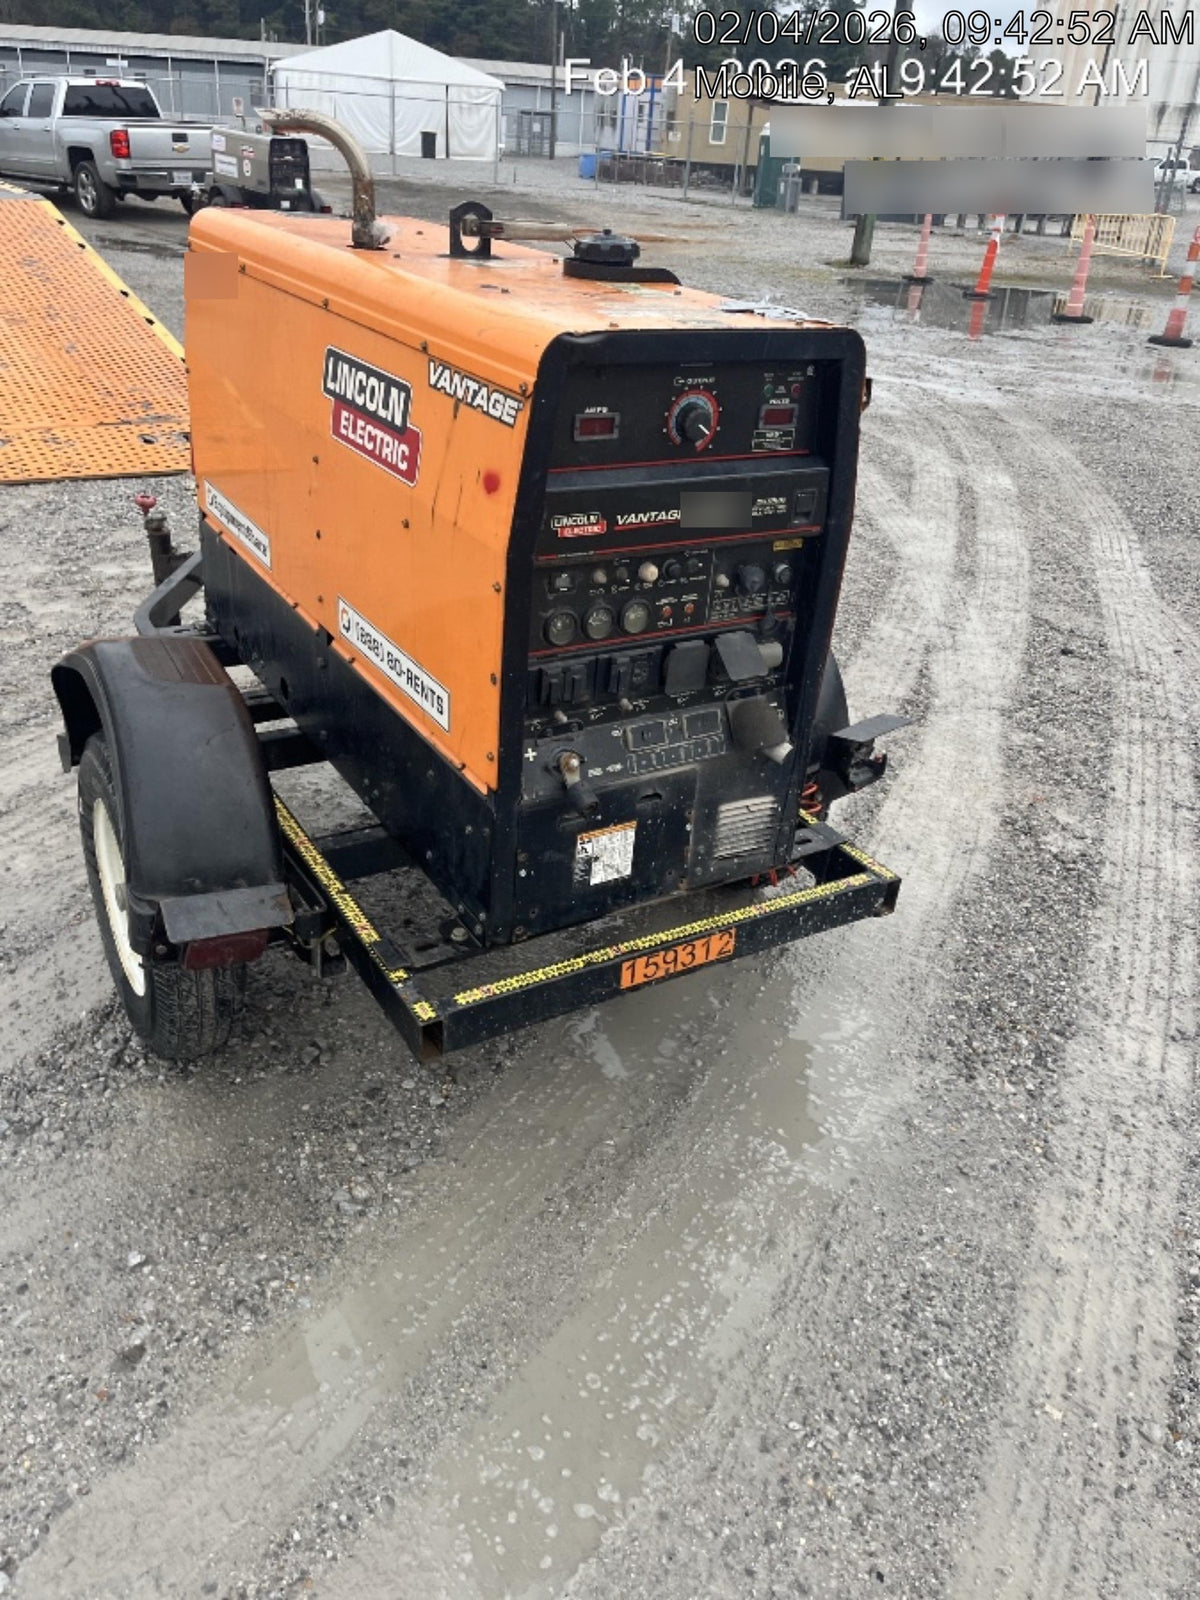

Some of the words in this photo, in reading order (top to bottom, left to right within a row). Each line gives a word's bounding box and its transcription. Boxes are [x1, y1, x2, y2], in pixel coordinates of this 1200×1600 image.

[326, 356, 406, 428] LINCOLN
[428, 360, 520, 425] VANTAGE
[339, 410, 410, 471] ELECTRIC
[554, 514, 598, 527] LINCOLN
[625, 930, 733, 984] 159312
